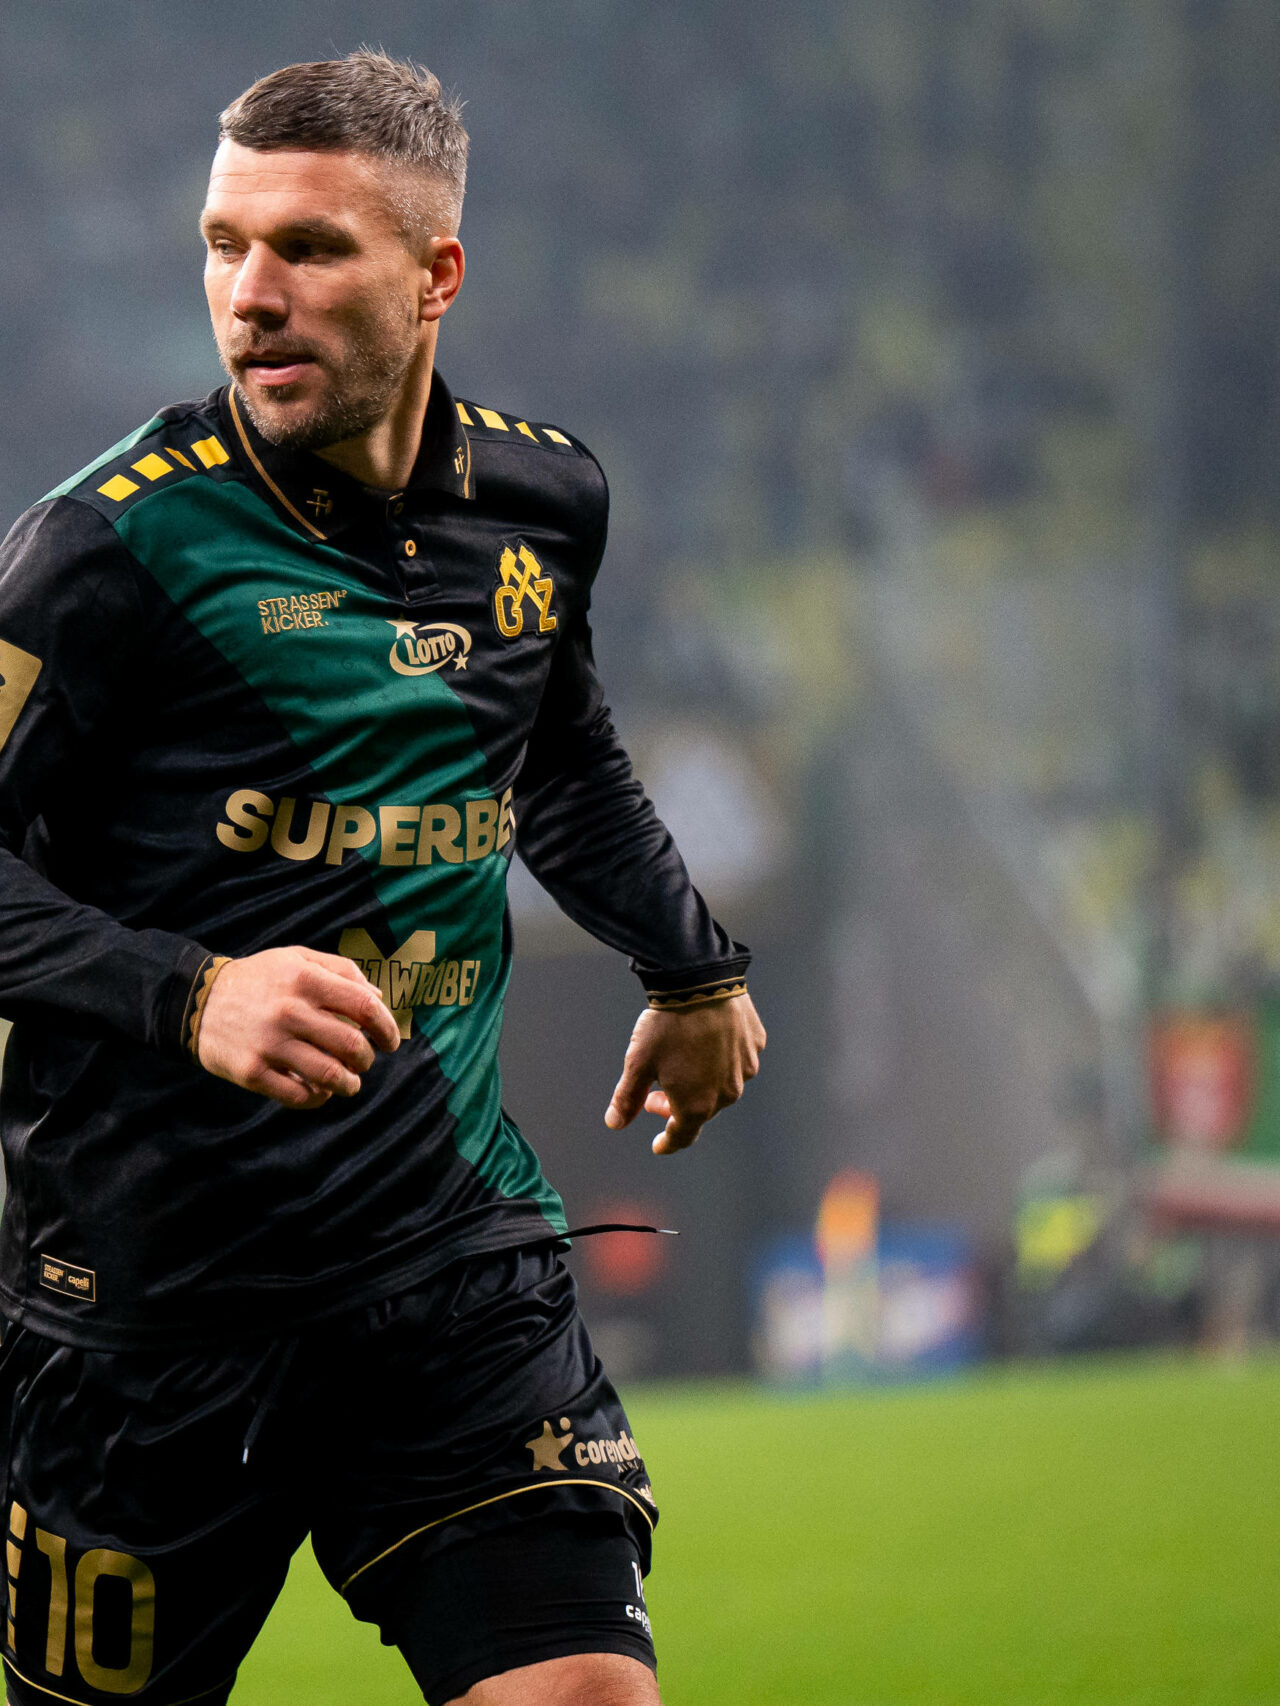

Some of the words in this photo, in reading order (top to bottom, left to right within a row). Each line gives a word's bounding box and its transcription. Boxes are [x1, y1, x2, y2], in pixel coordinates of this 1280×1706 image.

[257, 591, 339, 616] STRASSEN
[261, 611, 329, 635] KICKER.
[403, 631, 456, 666] LOTTO
[35, 1526, 156, 1695] 10
